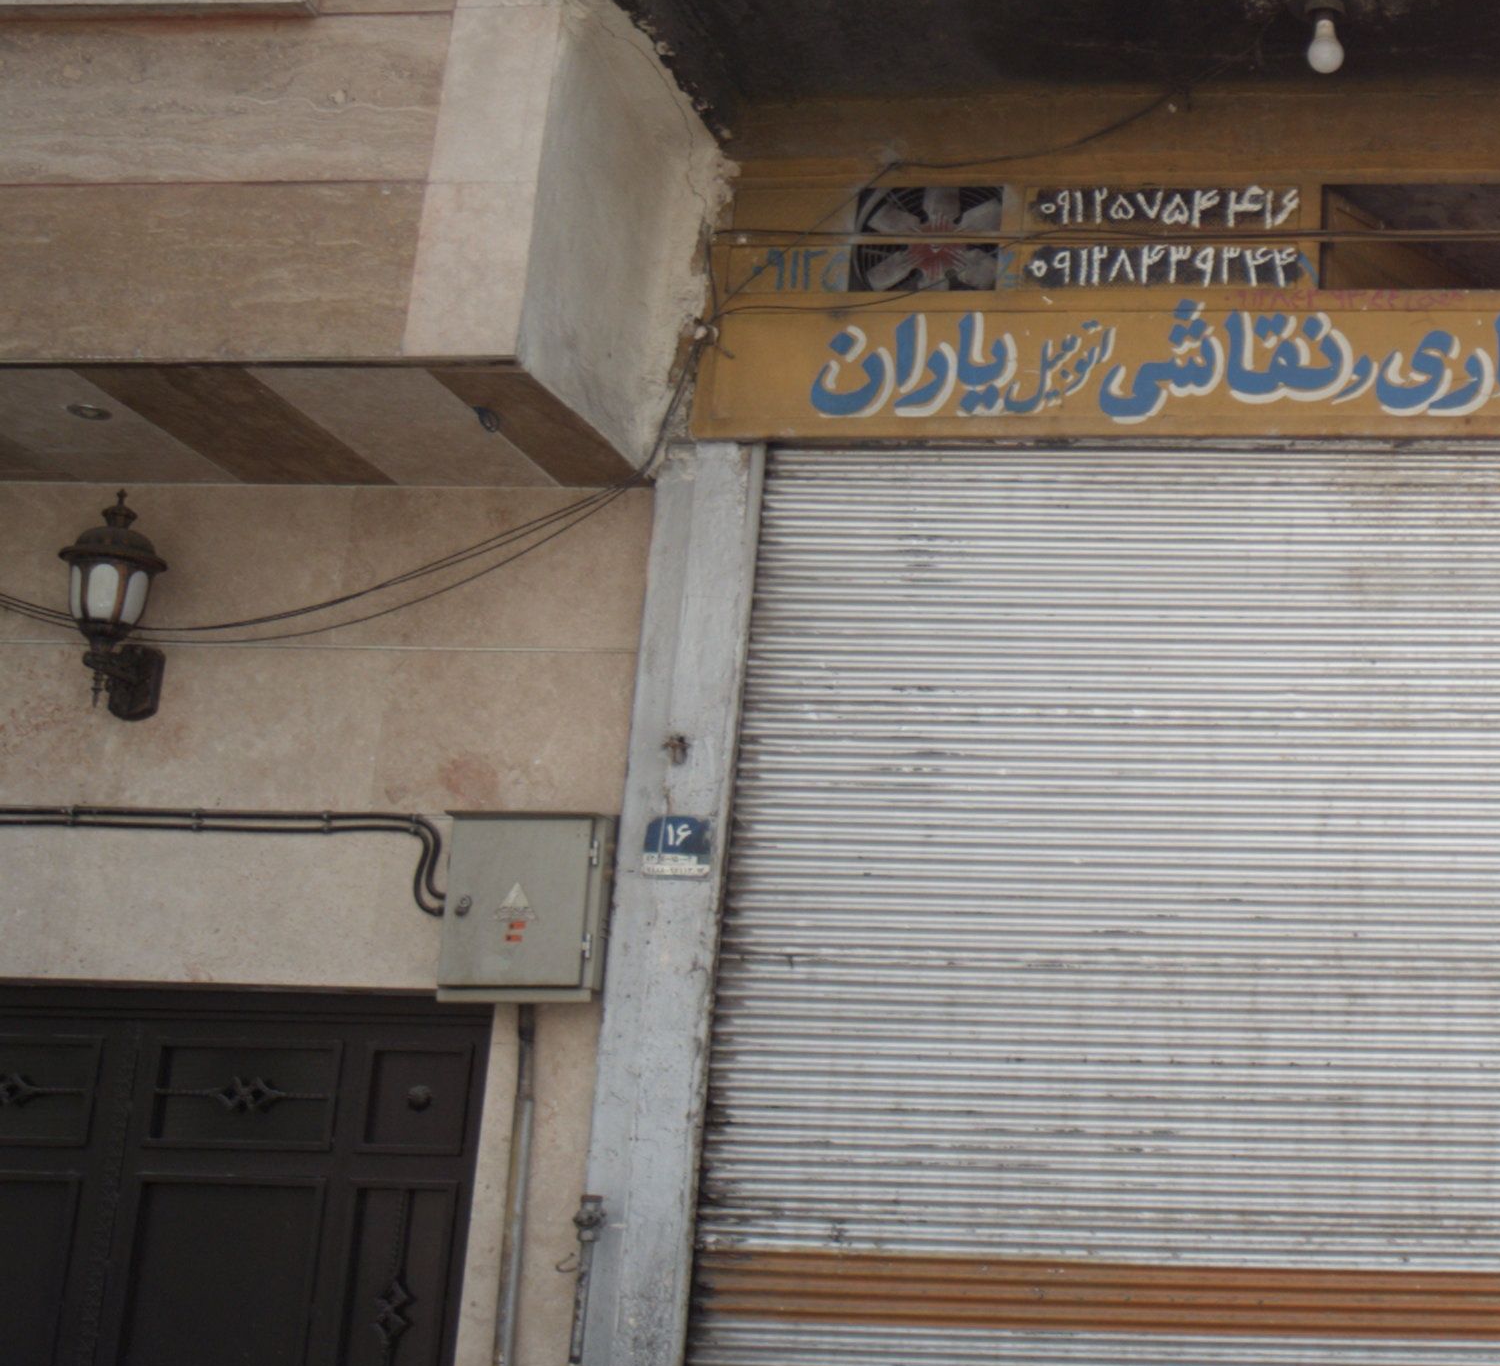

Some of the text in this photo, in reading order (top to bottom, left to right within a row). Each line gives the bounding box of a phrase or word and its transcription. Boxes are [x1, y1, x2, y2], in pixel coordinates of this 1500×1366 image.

[810, 310, 1017, 419] یاران
[1099, 298, 1353, 424] نقاشی
[1330, 351, 1379, 404] و
[666, 822, 693, 847] ۱۶
